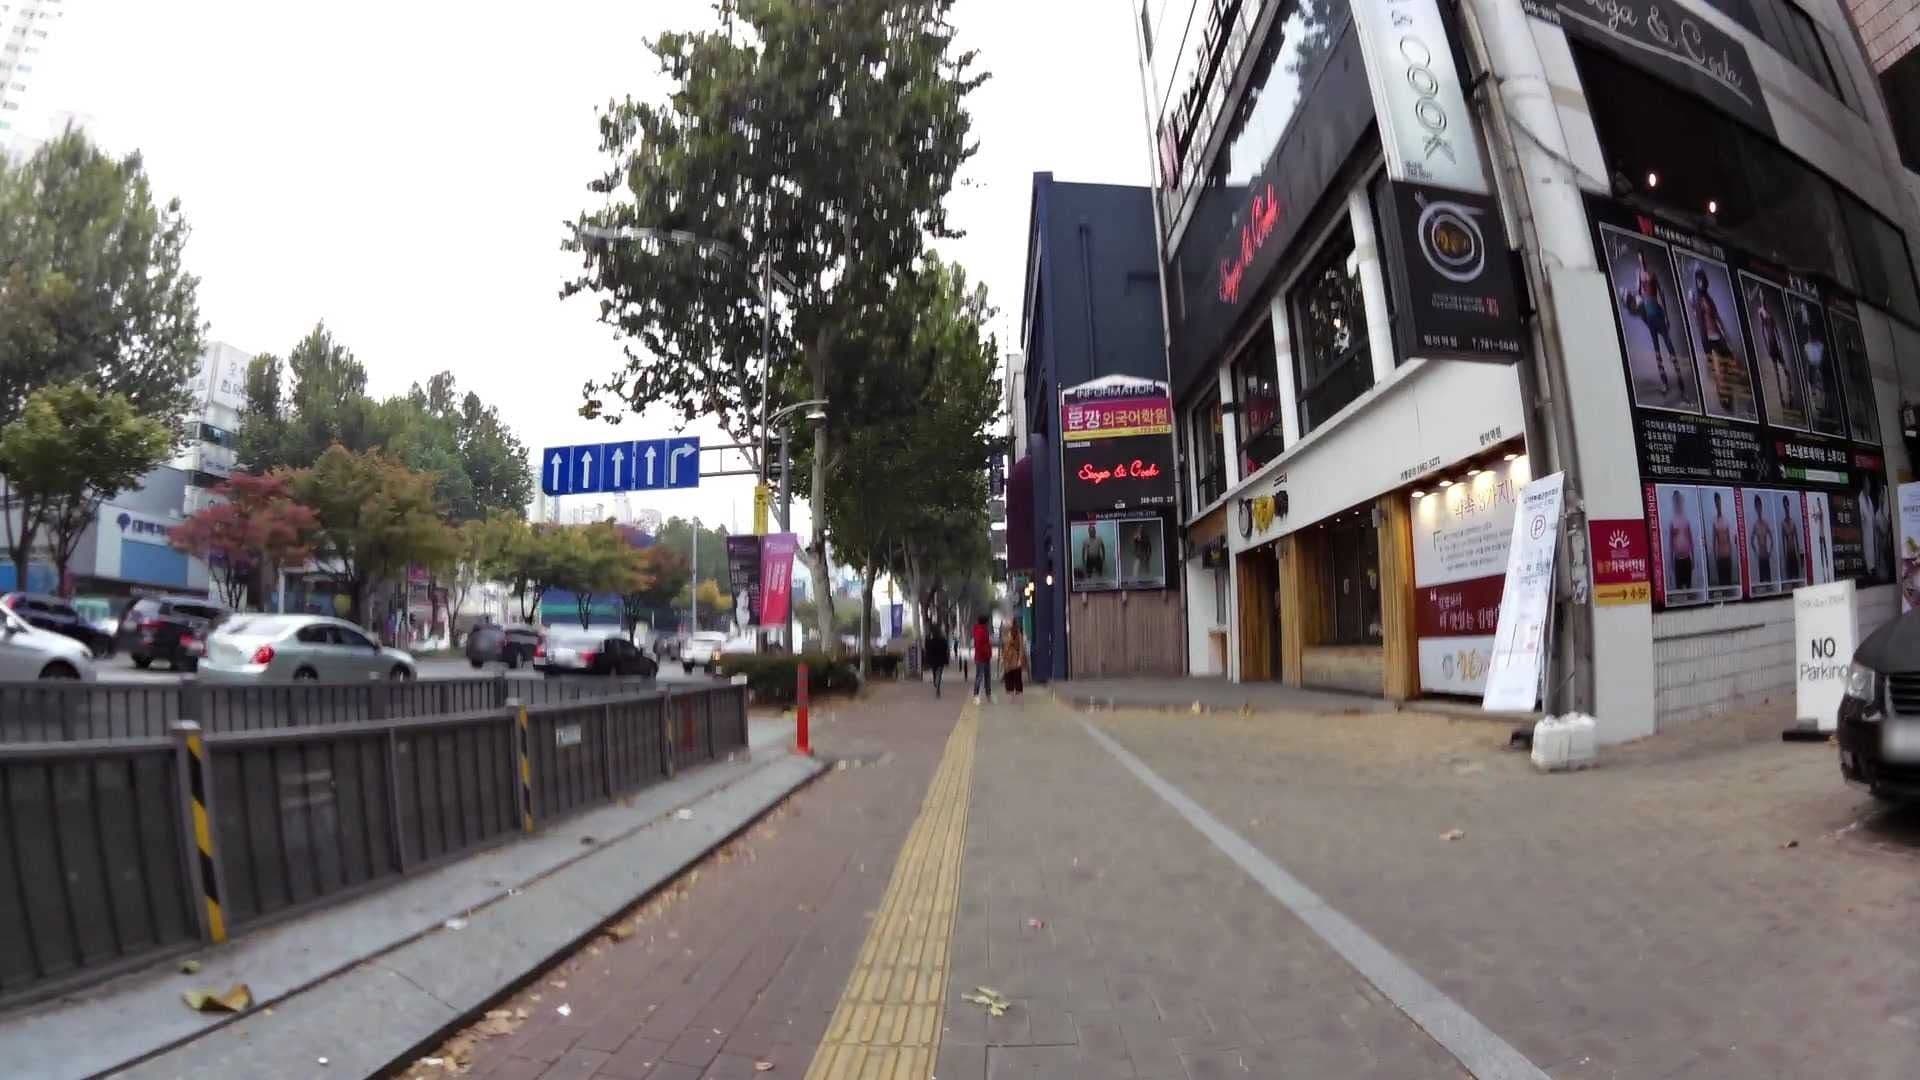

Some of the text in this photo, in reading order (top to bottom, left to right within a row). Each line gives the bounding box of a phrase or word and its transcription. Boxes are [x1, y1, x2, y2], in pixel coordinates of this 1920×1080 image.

[1401, 34, 1457, 165] COOK
[1130, 459, 1160, 478] Cook
[1811, 636, 1836, 659] NO
